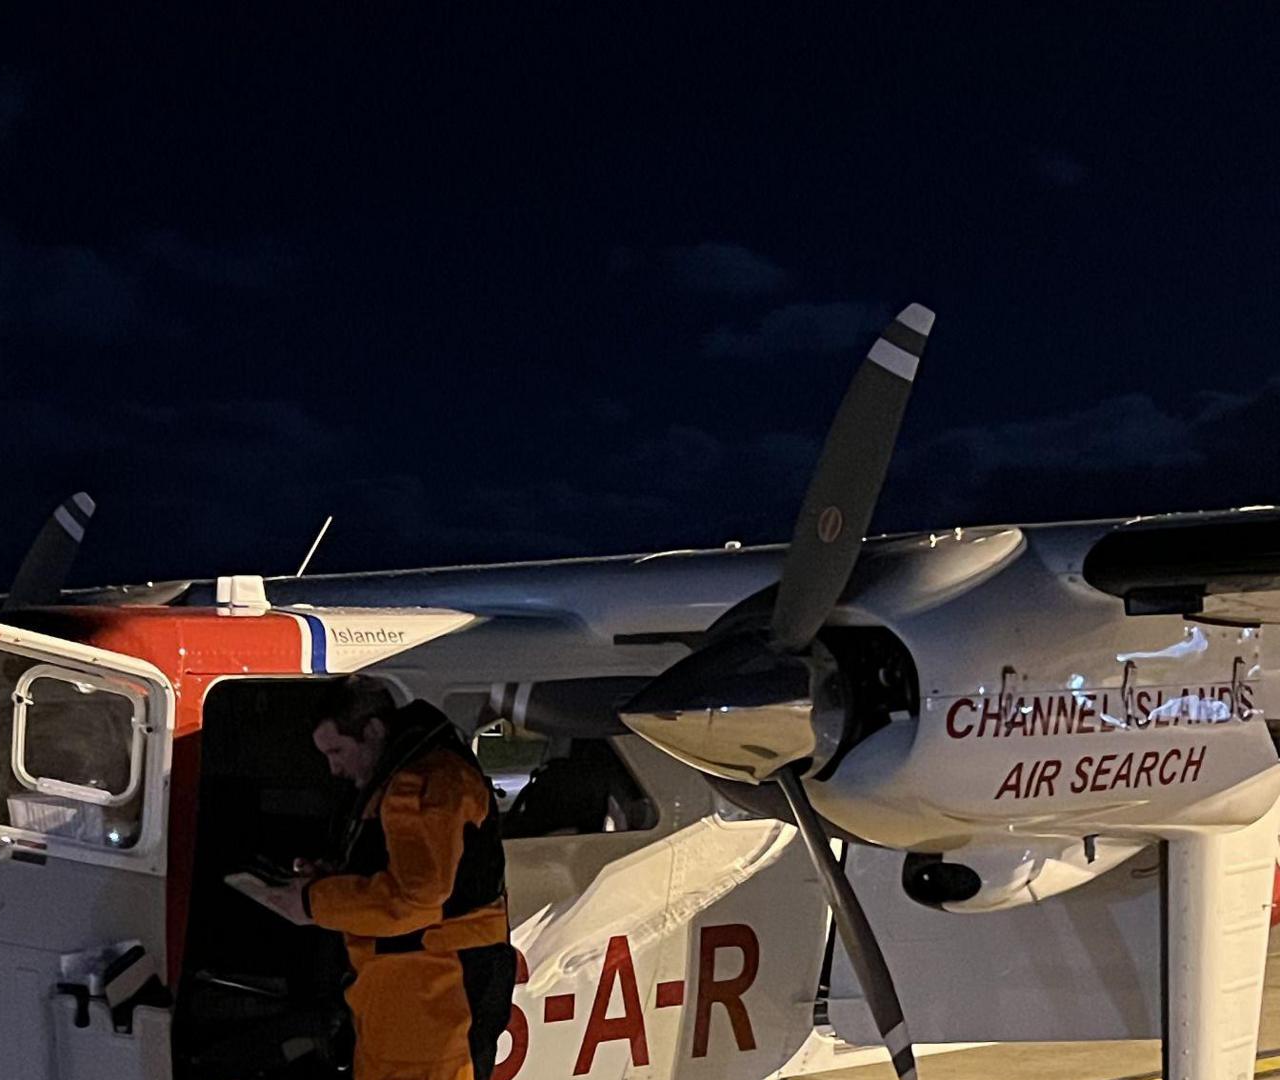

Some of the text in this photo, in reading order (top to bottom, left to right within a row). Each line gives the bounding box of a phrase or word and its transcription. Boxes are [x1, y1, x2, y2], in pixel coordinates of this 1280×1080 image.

[331, 628, 405, 643] Islander
[945, 683, 1256, 740] CHANNEL ISLANDS
[993, 745, 1208, 800] AIR SEARCH
